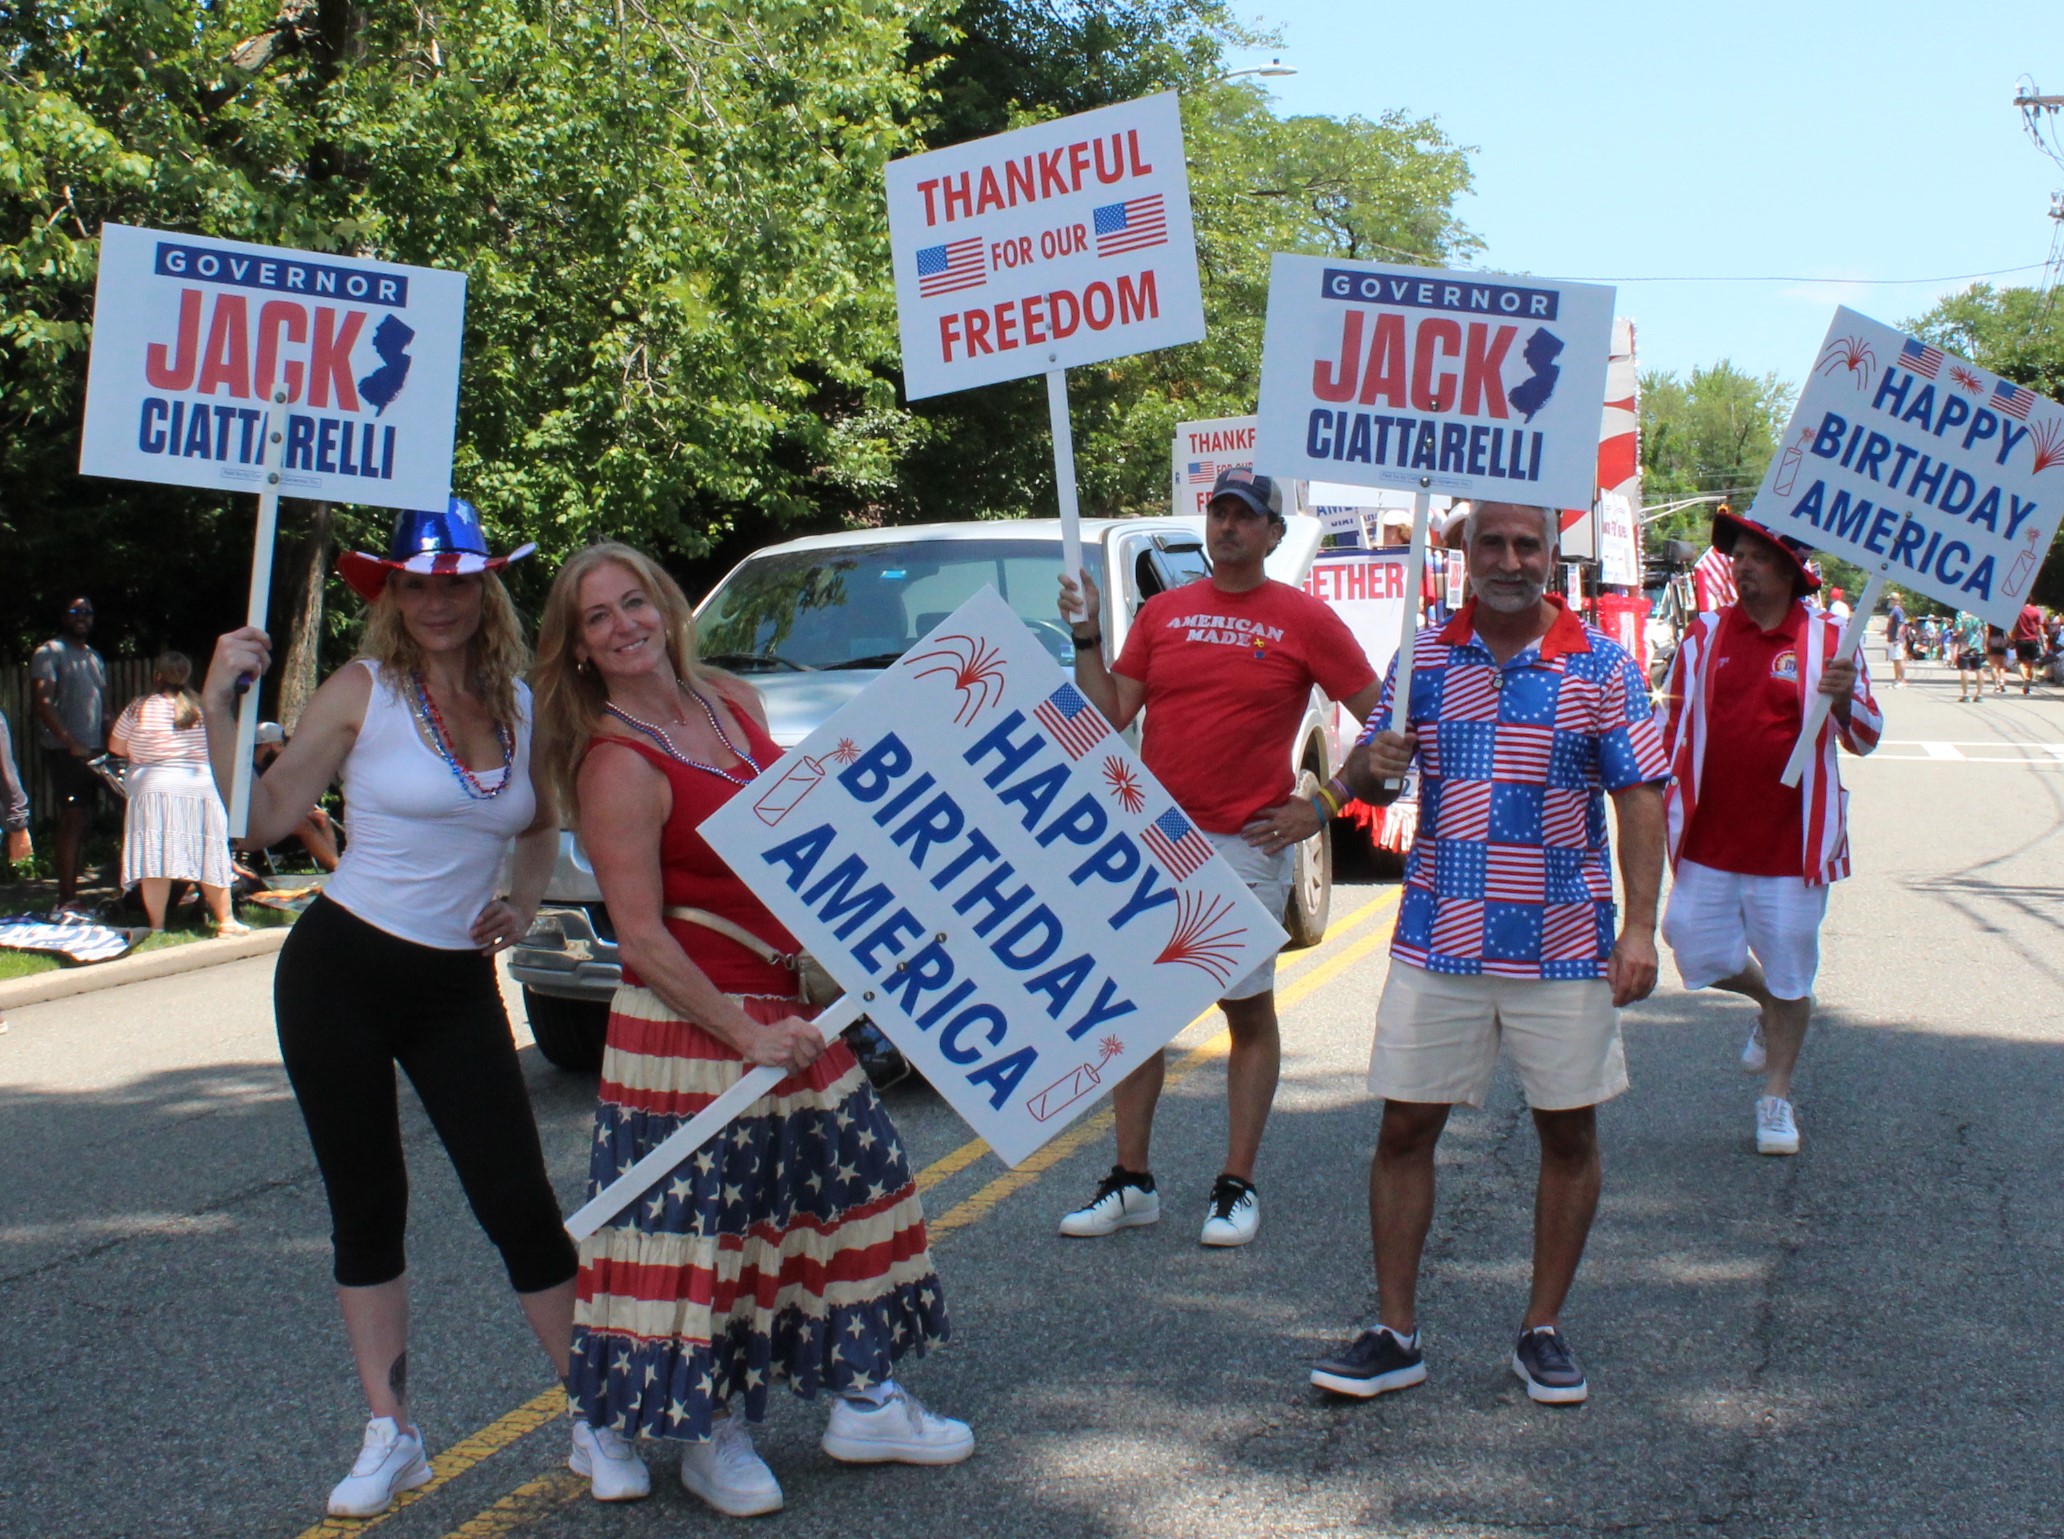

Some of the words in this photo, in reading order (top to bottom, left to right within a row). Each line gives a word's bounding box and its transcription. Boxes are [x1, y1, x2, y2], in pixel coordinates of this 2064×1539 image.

[918, 130, 1152, 227] THANKFUL
[167, 251, 398, 302] GOVERNOR
[992, 236, 1033, 271] FOR
[1041, 224, 1088, 259] OUR
[1331, 275, 1549, 316] GOVERNOR
[146, 288, 367, 412] JACK
[940, 270, 1159, 363] FREEDOM
[1312, 310, 1518, 420] JACK
[1189, 428, 1256, 454] THANKF
[1306, 408, 1544, 482] CIATTARELLI
[1872, 366, 2029, 465] HAPPY
[1810, 412, 2037, 540] BIRTHDAY
[1790, 480, 1995, 601] AMERICA
[1166, 613, 1285, 642] AMERICAN
[1186, 627, 1252, 648] MADE
[963, 709, 1177, 931] HAPPY
[837, 732, 1137, 1041] BIRTHDAY
[761, 823, 1040, 1111] AMERICA
